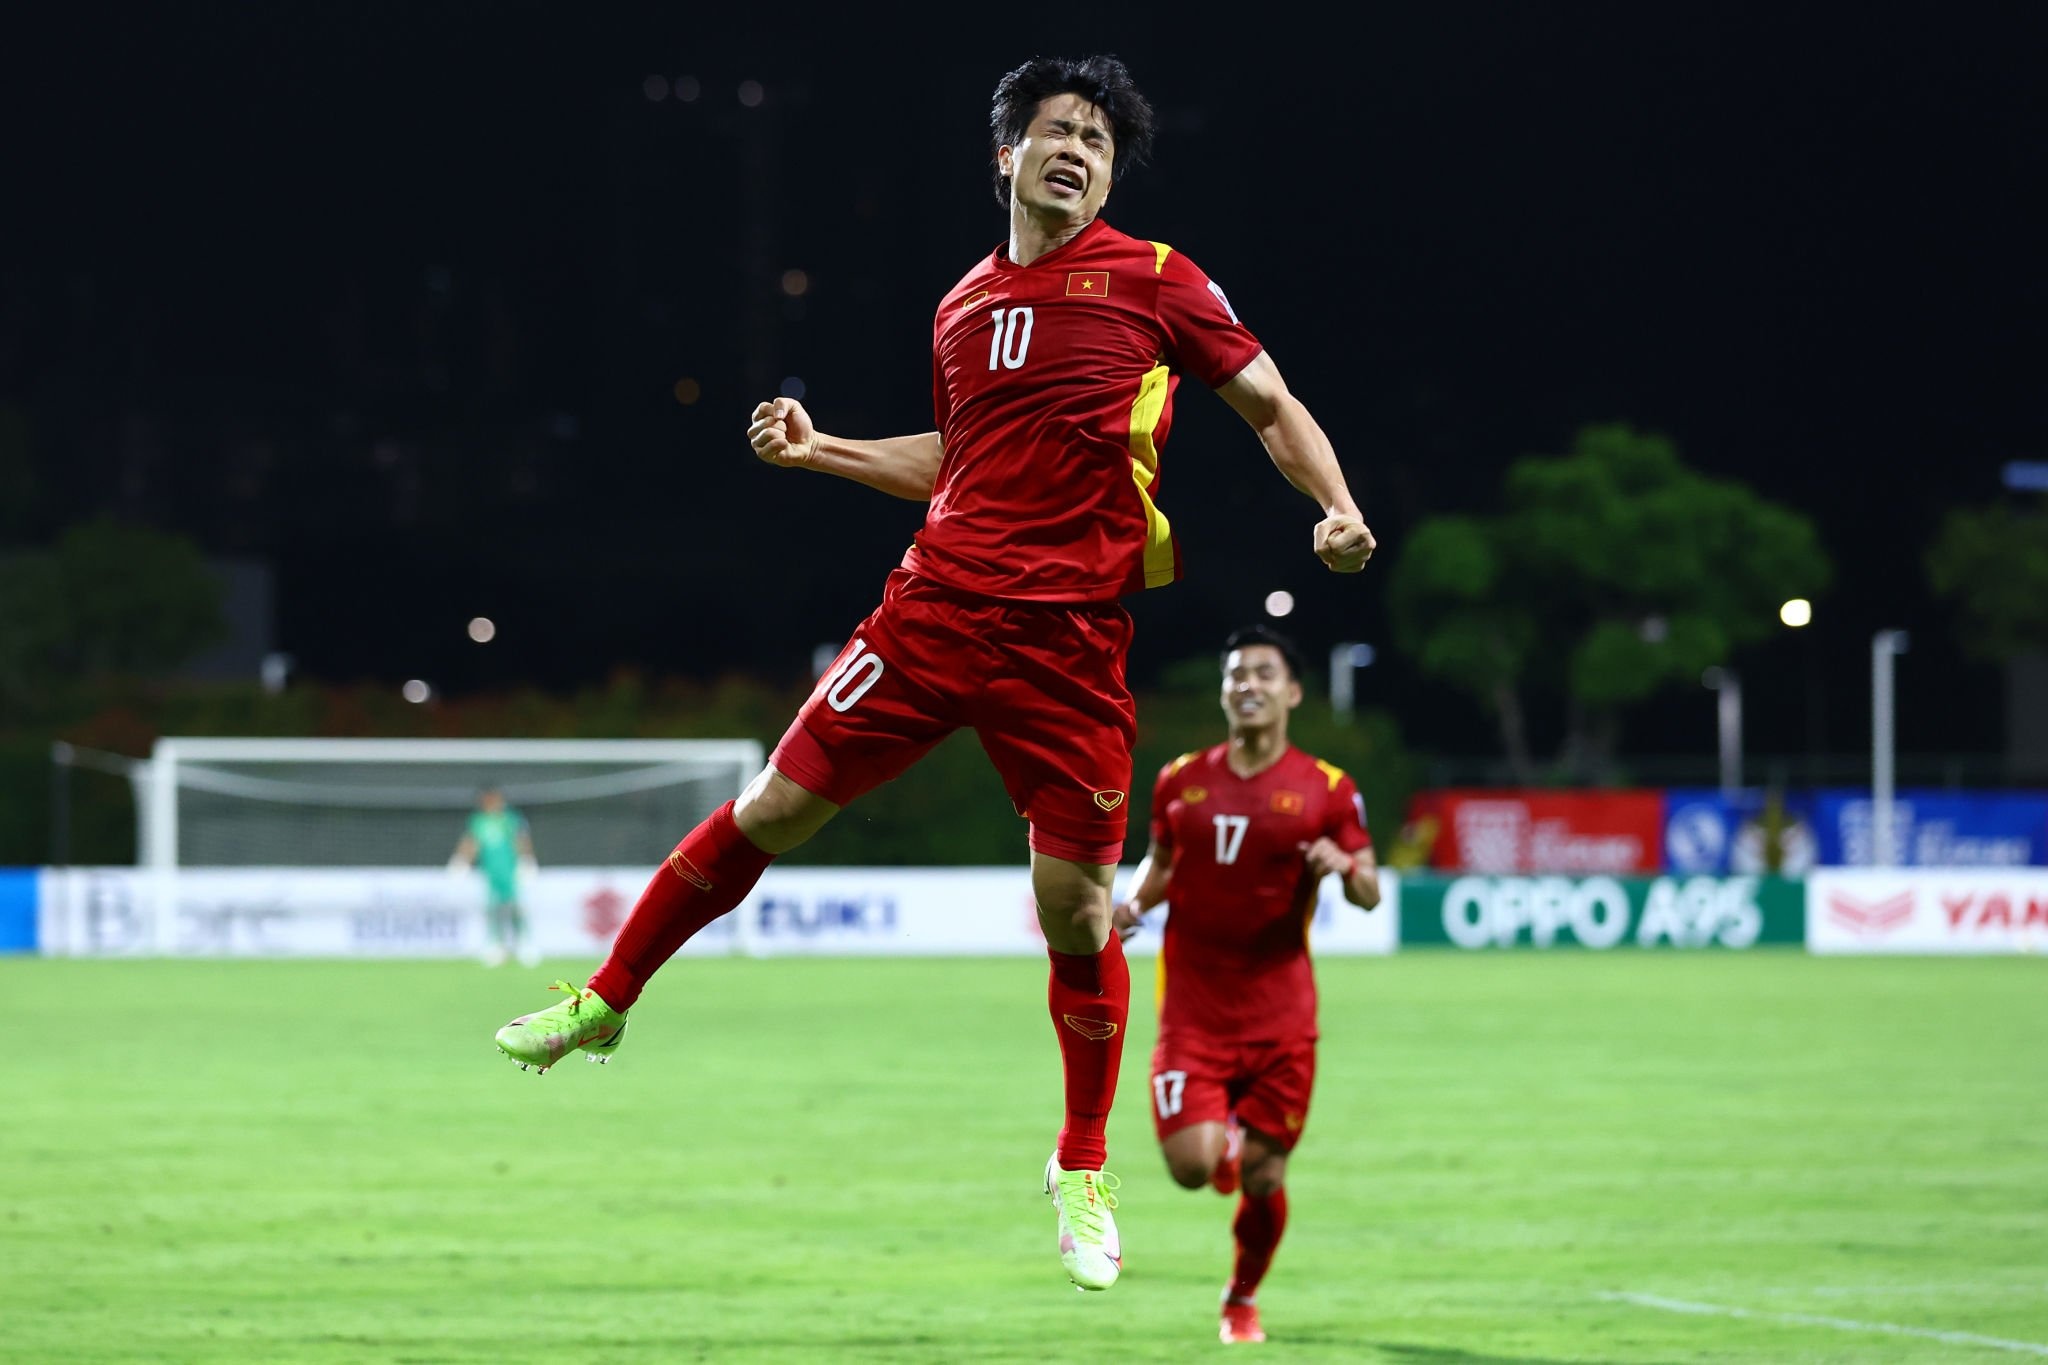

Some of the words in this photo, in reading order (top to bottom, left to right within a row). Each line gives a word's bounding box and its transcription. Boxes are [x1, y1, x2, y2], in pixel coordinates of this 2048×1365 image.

[988, 306, 1034, 371] 10
[820, 638, 884, 712] 10
[1213, 815, 1250, 864] 17
[1442, 876, 1630, 948] OPPO
[1637, 876, 1763, 948] A95
[1152, 1070, 1187, 1120] 17
